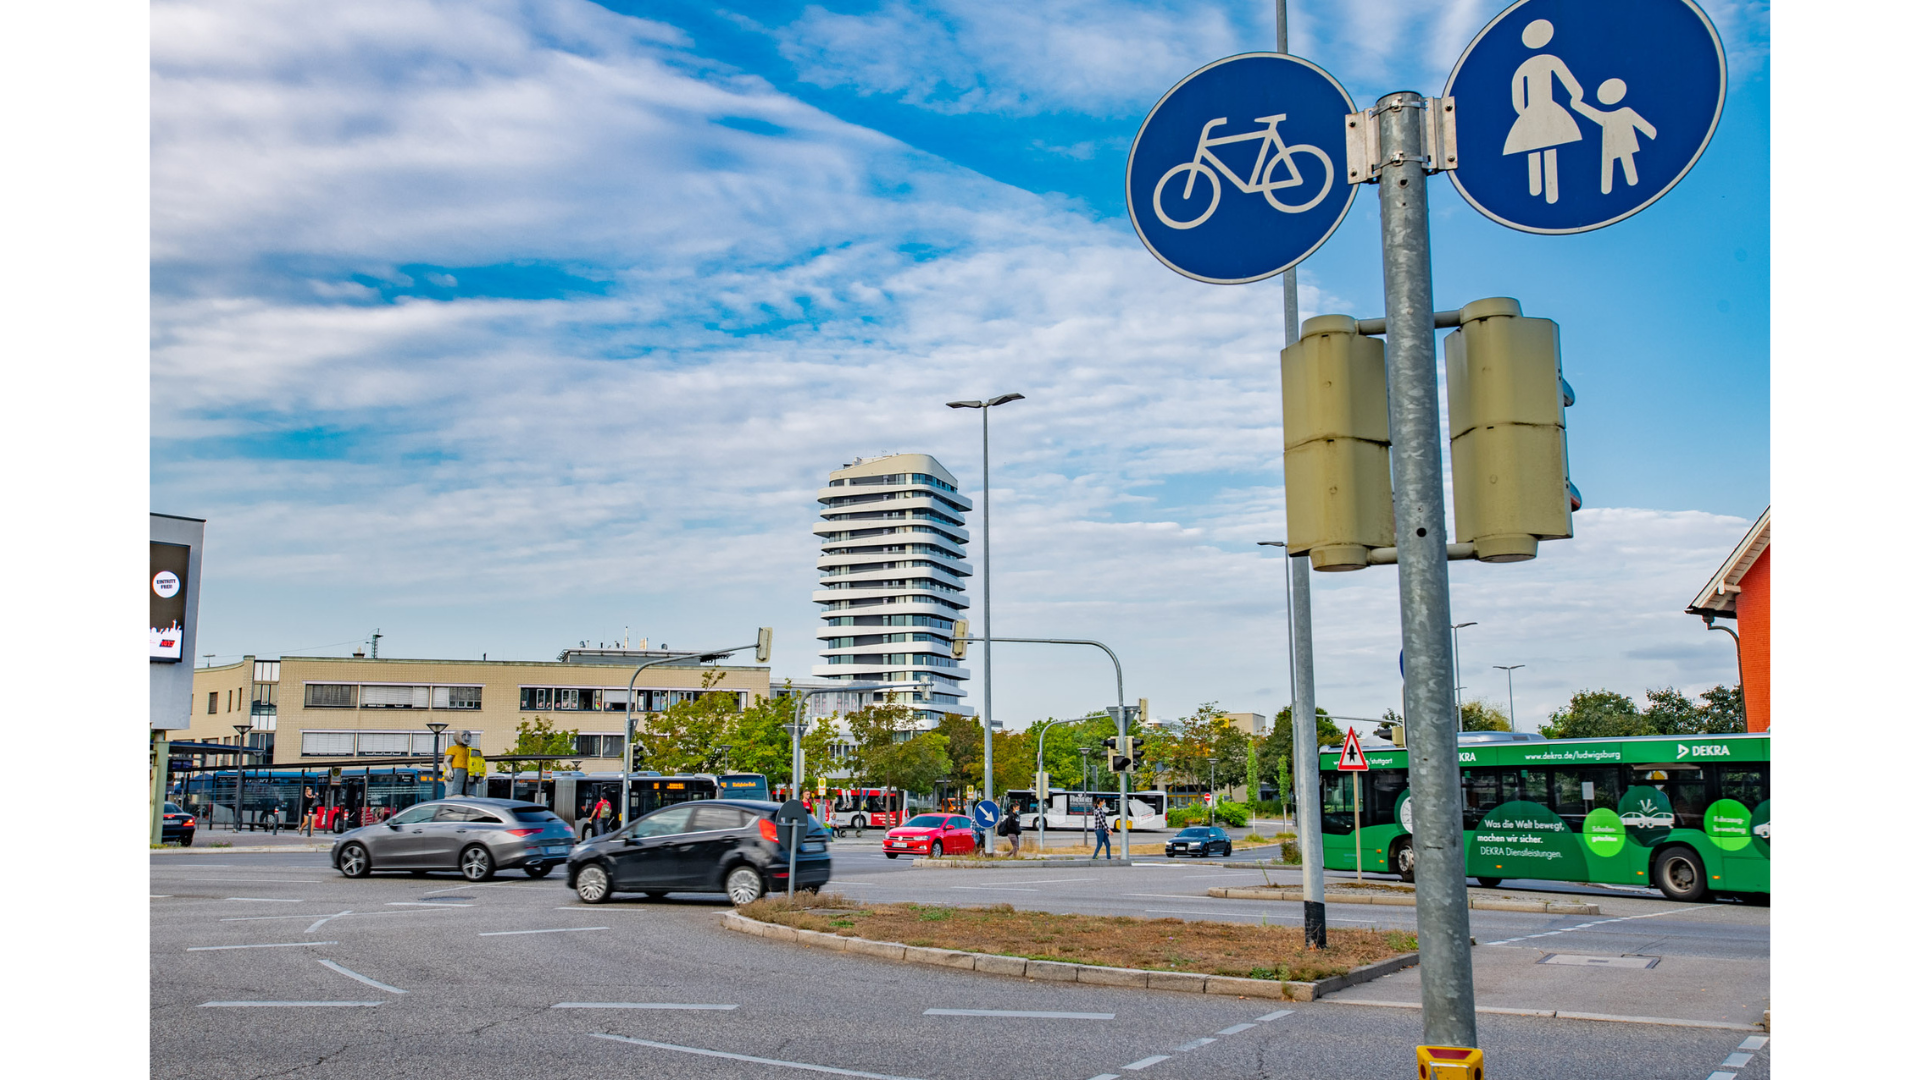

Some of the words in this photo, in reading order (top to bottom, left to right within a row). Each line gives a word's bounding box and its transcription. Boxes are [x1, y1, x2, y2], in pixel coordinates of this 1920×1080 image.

[1525, 751, 1620, 760] www.dekra.de/ludwigsburg
[1692, 745, 1730, 757] DEKRA
[1458, 752, 1476, 762] KRA
[1484, 819, 1501, 829] Was
[1502, 819, 1514, 829] die
[1515, 820, 1533, 829] Welt
[1534, 820, 1565, 831] bewegt,
[1477, 833, 1505, 842] machen
[1506, 834, 1518, 842] wir
[1519, 834, 1543, 844] sicher.
[1480, 846, 1504, 855] DEKRA
[1505, 847, 1563, 860] Dienstleistungen.
